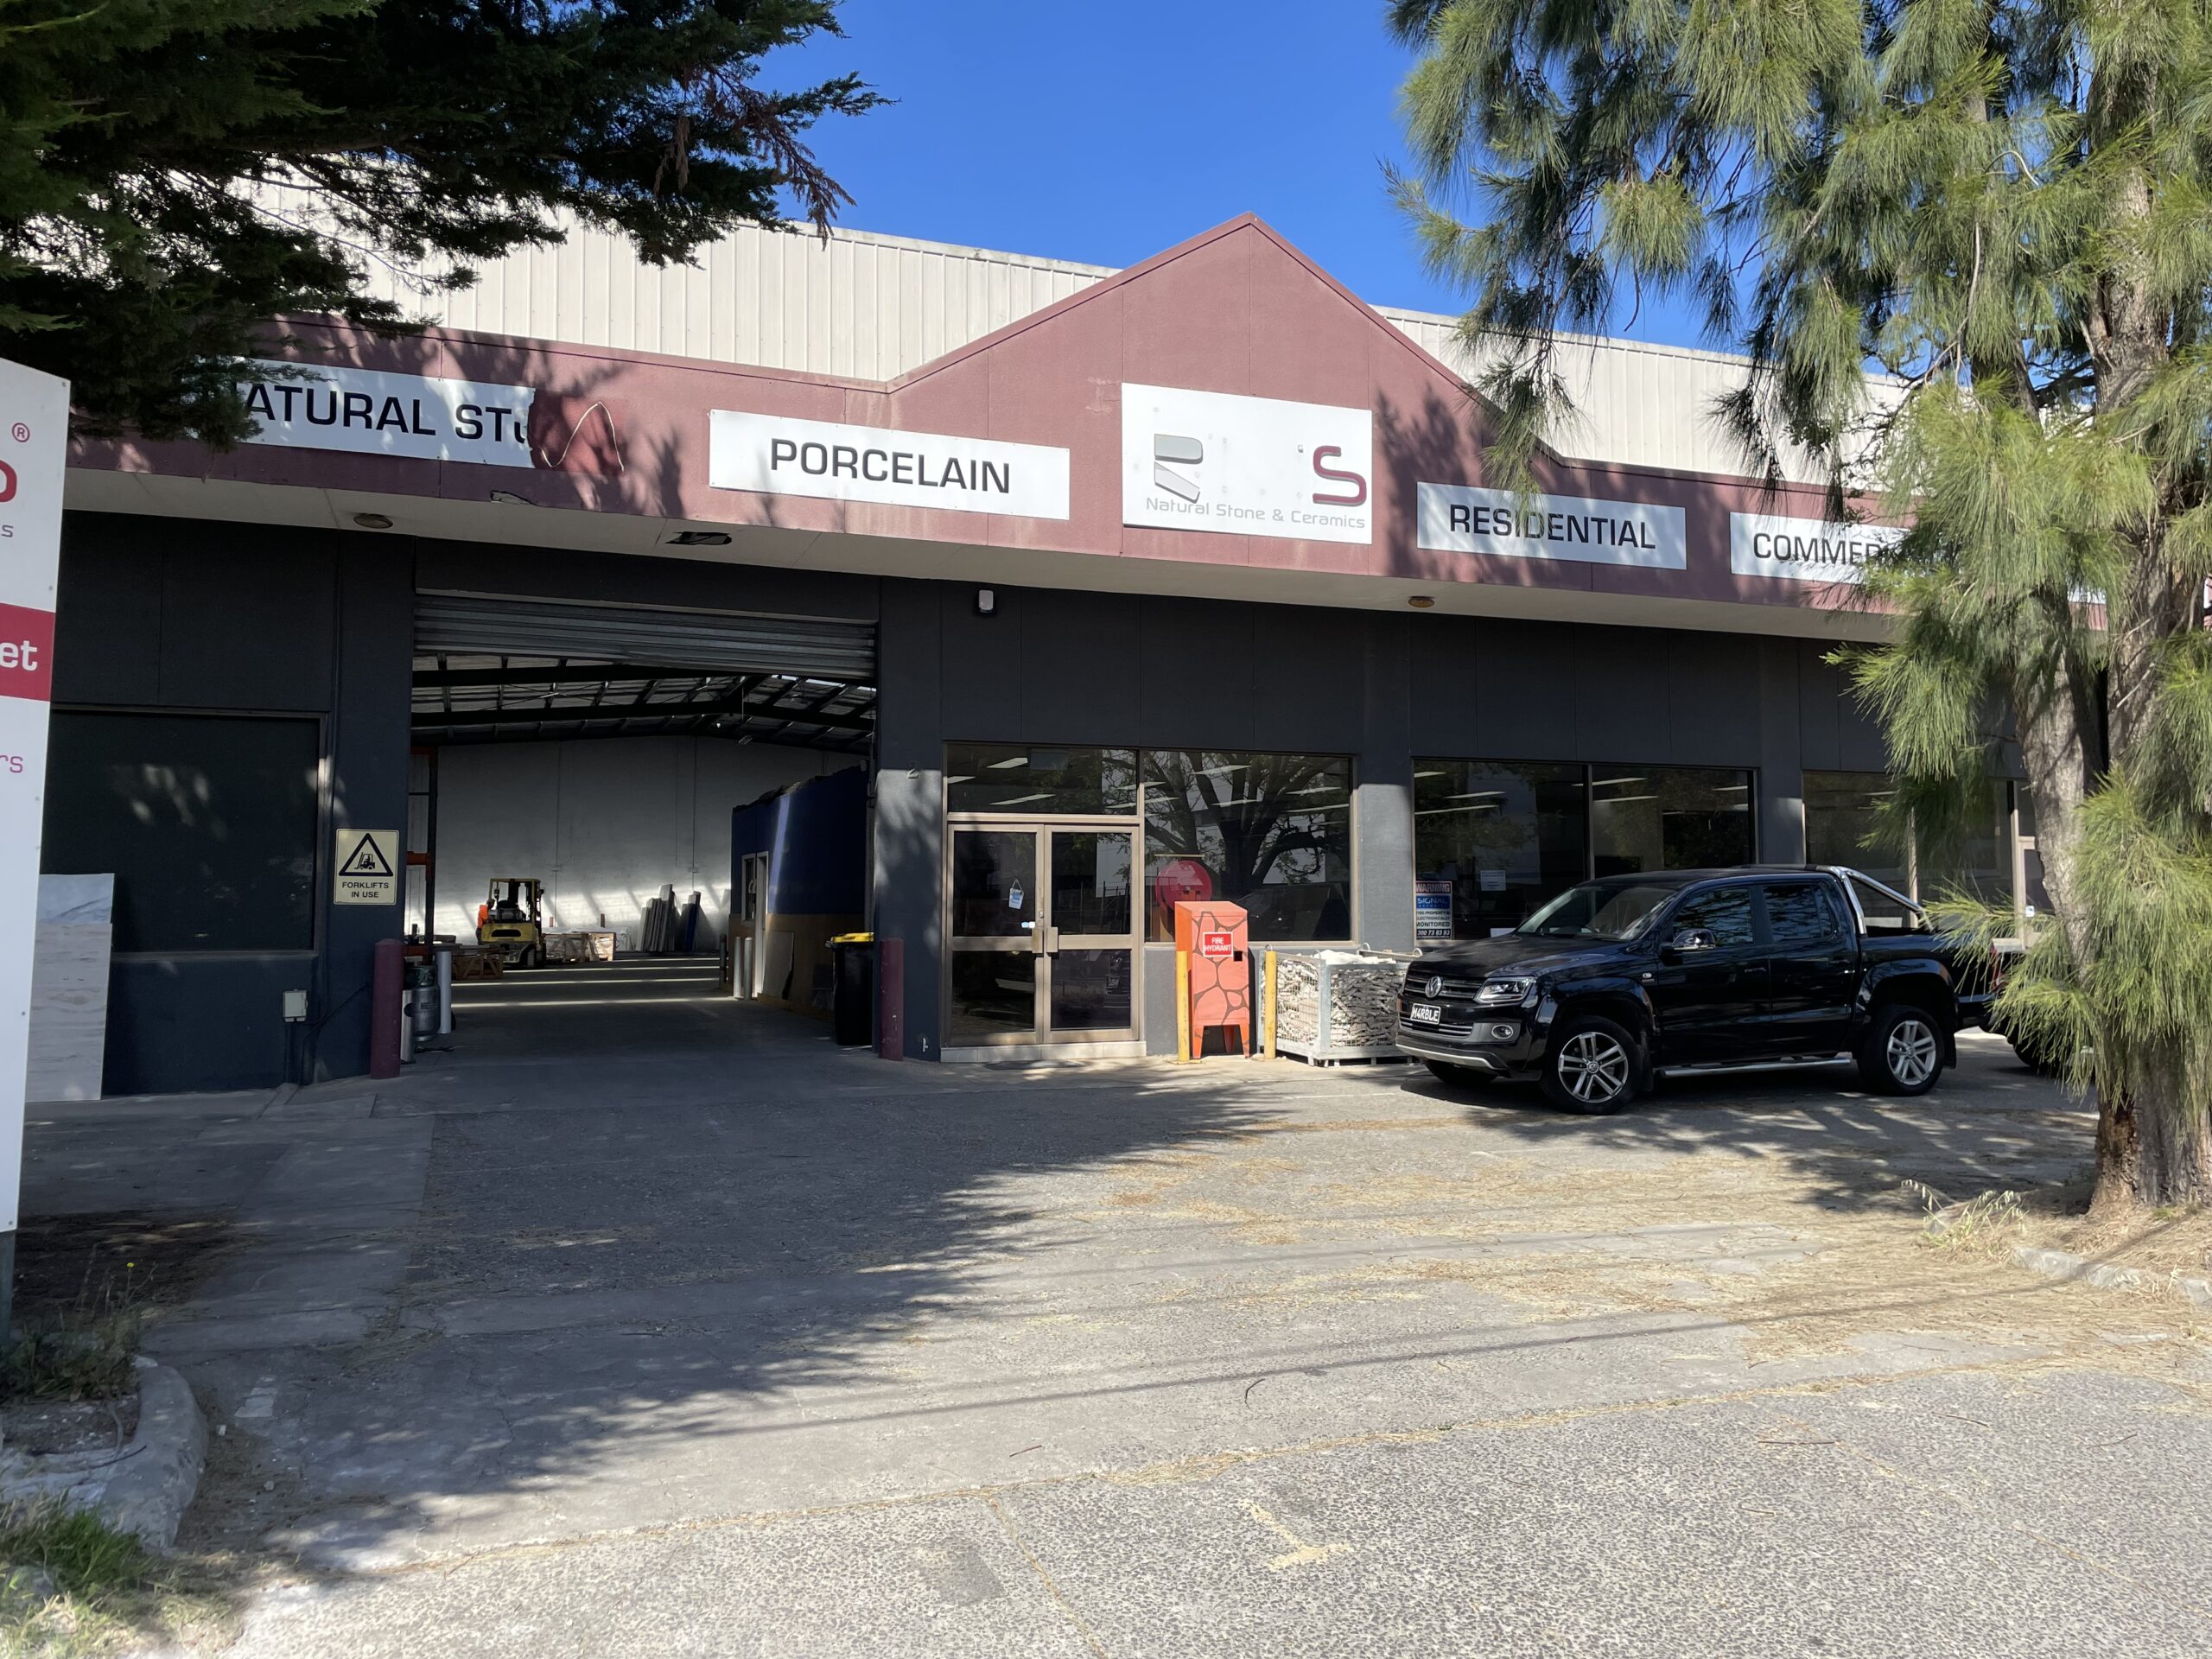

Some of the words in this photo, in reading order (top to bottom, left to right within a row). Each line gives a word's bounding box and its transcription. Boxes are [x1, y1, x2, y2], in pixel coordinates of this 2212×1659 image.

[771, 437, 1009, 493] PORCELAIN
[1146, 497, 1209, 516] Natural
[1217, 504, 1265, 520] Stone
[1272, 509, 1284, 522] &
[1291, 511, 1365, 529] Ceramics
[1450, 504, 1656, 550] RESIDENTIAL
[1205, 944, 1231, 952] HYDRANT
